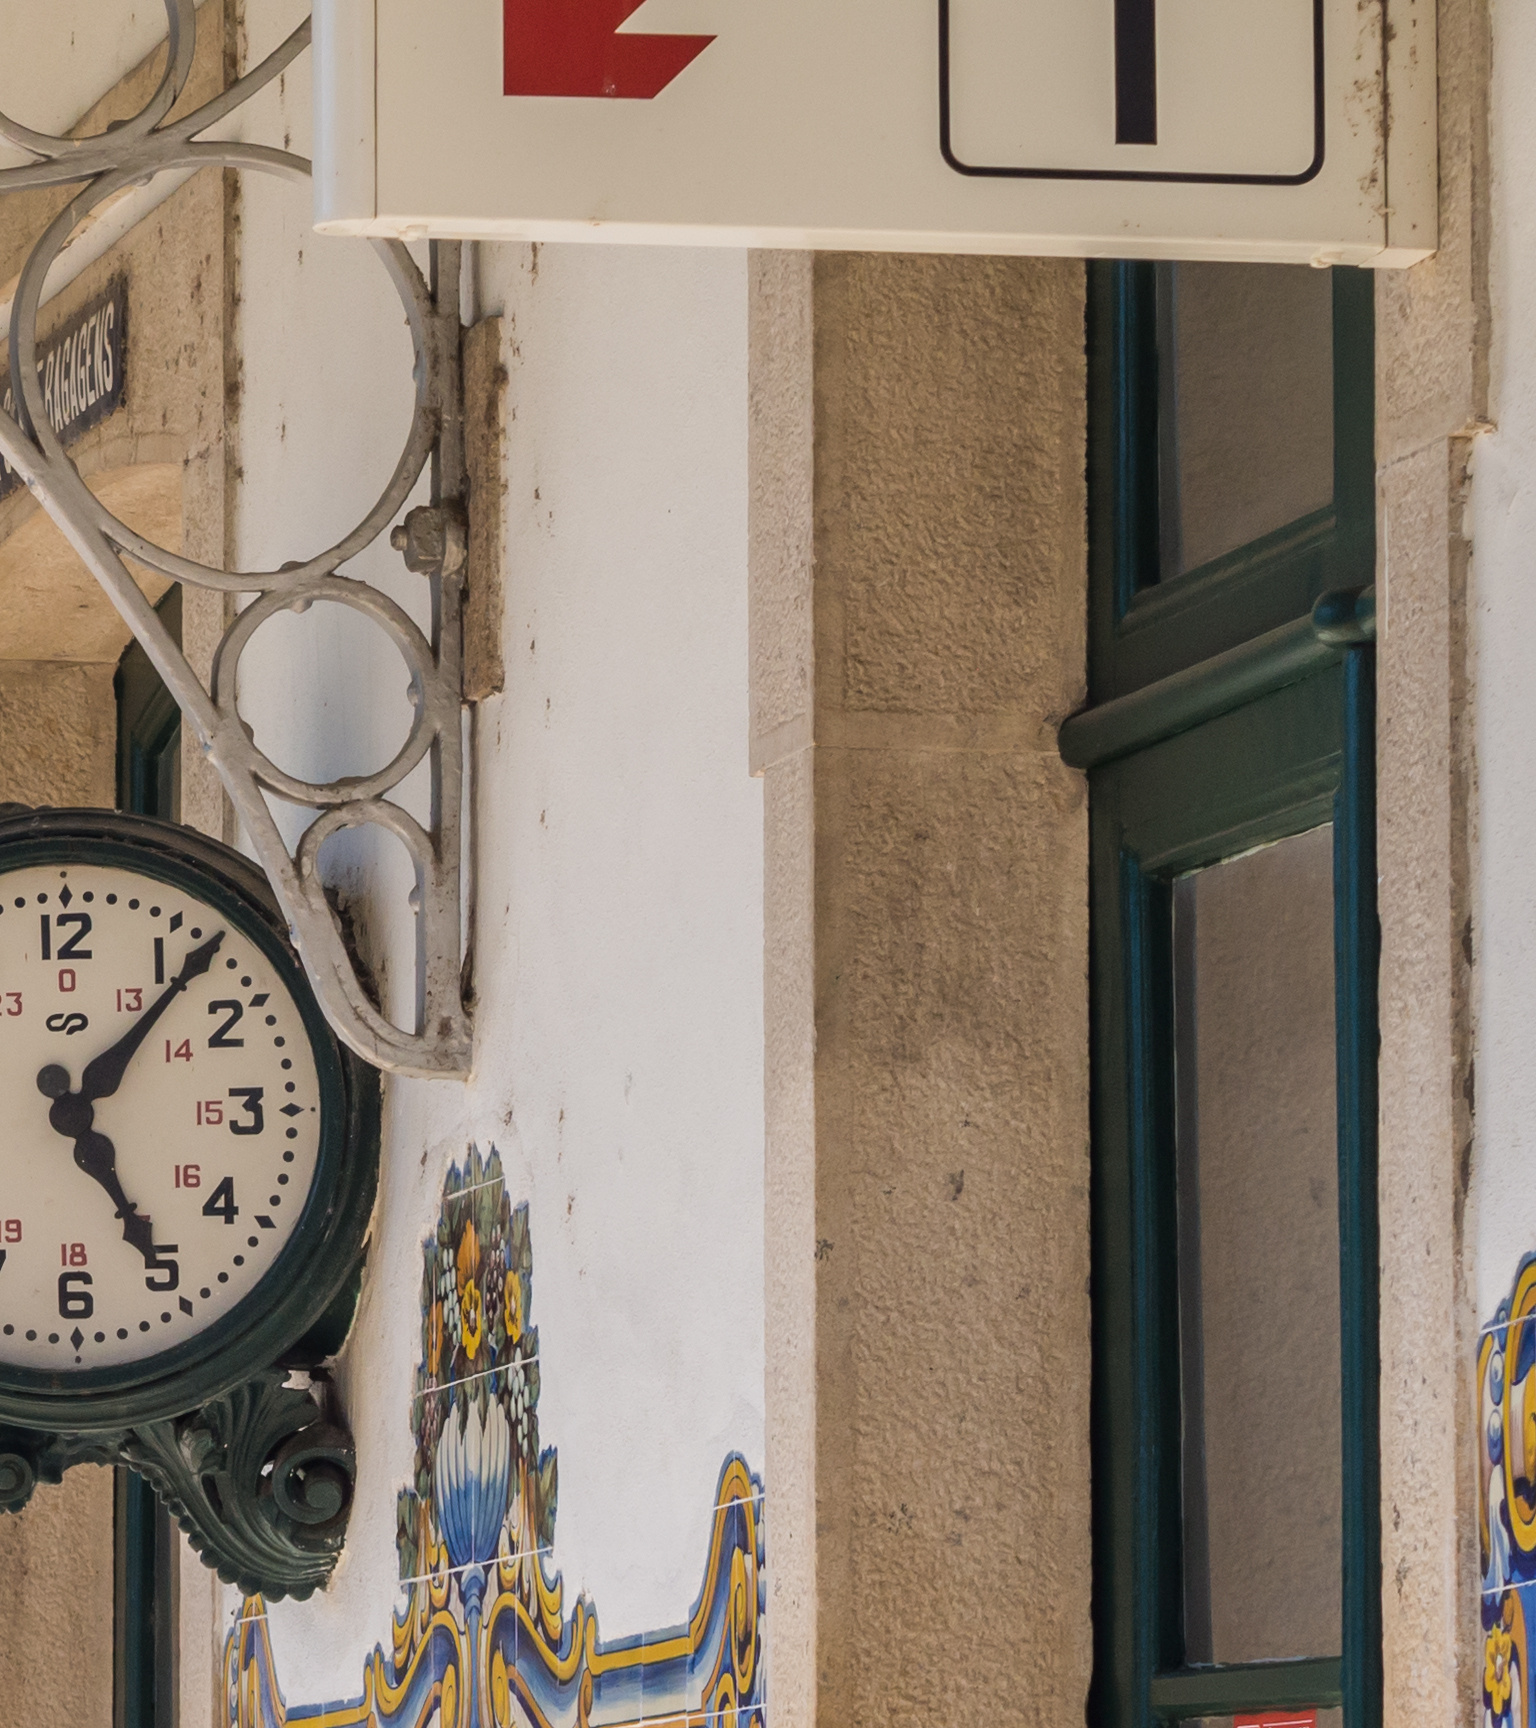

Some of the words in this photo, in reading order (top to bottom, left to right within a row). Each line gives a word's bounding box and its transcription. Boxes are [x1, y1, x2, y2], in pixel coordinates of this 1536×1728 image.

[41, 913, 92, 960] 12
[59, 969, 75, 992] 0
[154, 937, 164, 984] 1
[116, 989, 143, 1012] 13
[208, 1000, 244, 1048] 2
[166, 1039, 193, 1062] 14
[197, 1101, 223, 1125] 15
[229, 1087, 264, 1135] 3
[175, 1165, 200, 1188] 16
[202, 1177, 238, 1224] 4
[62, 1243, 87, 1266] 18
[145, 1245, 179, 1291] 5
[58, 1271, 93, 1319] 6
